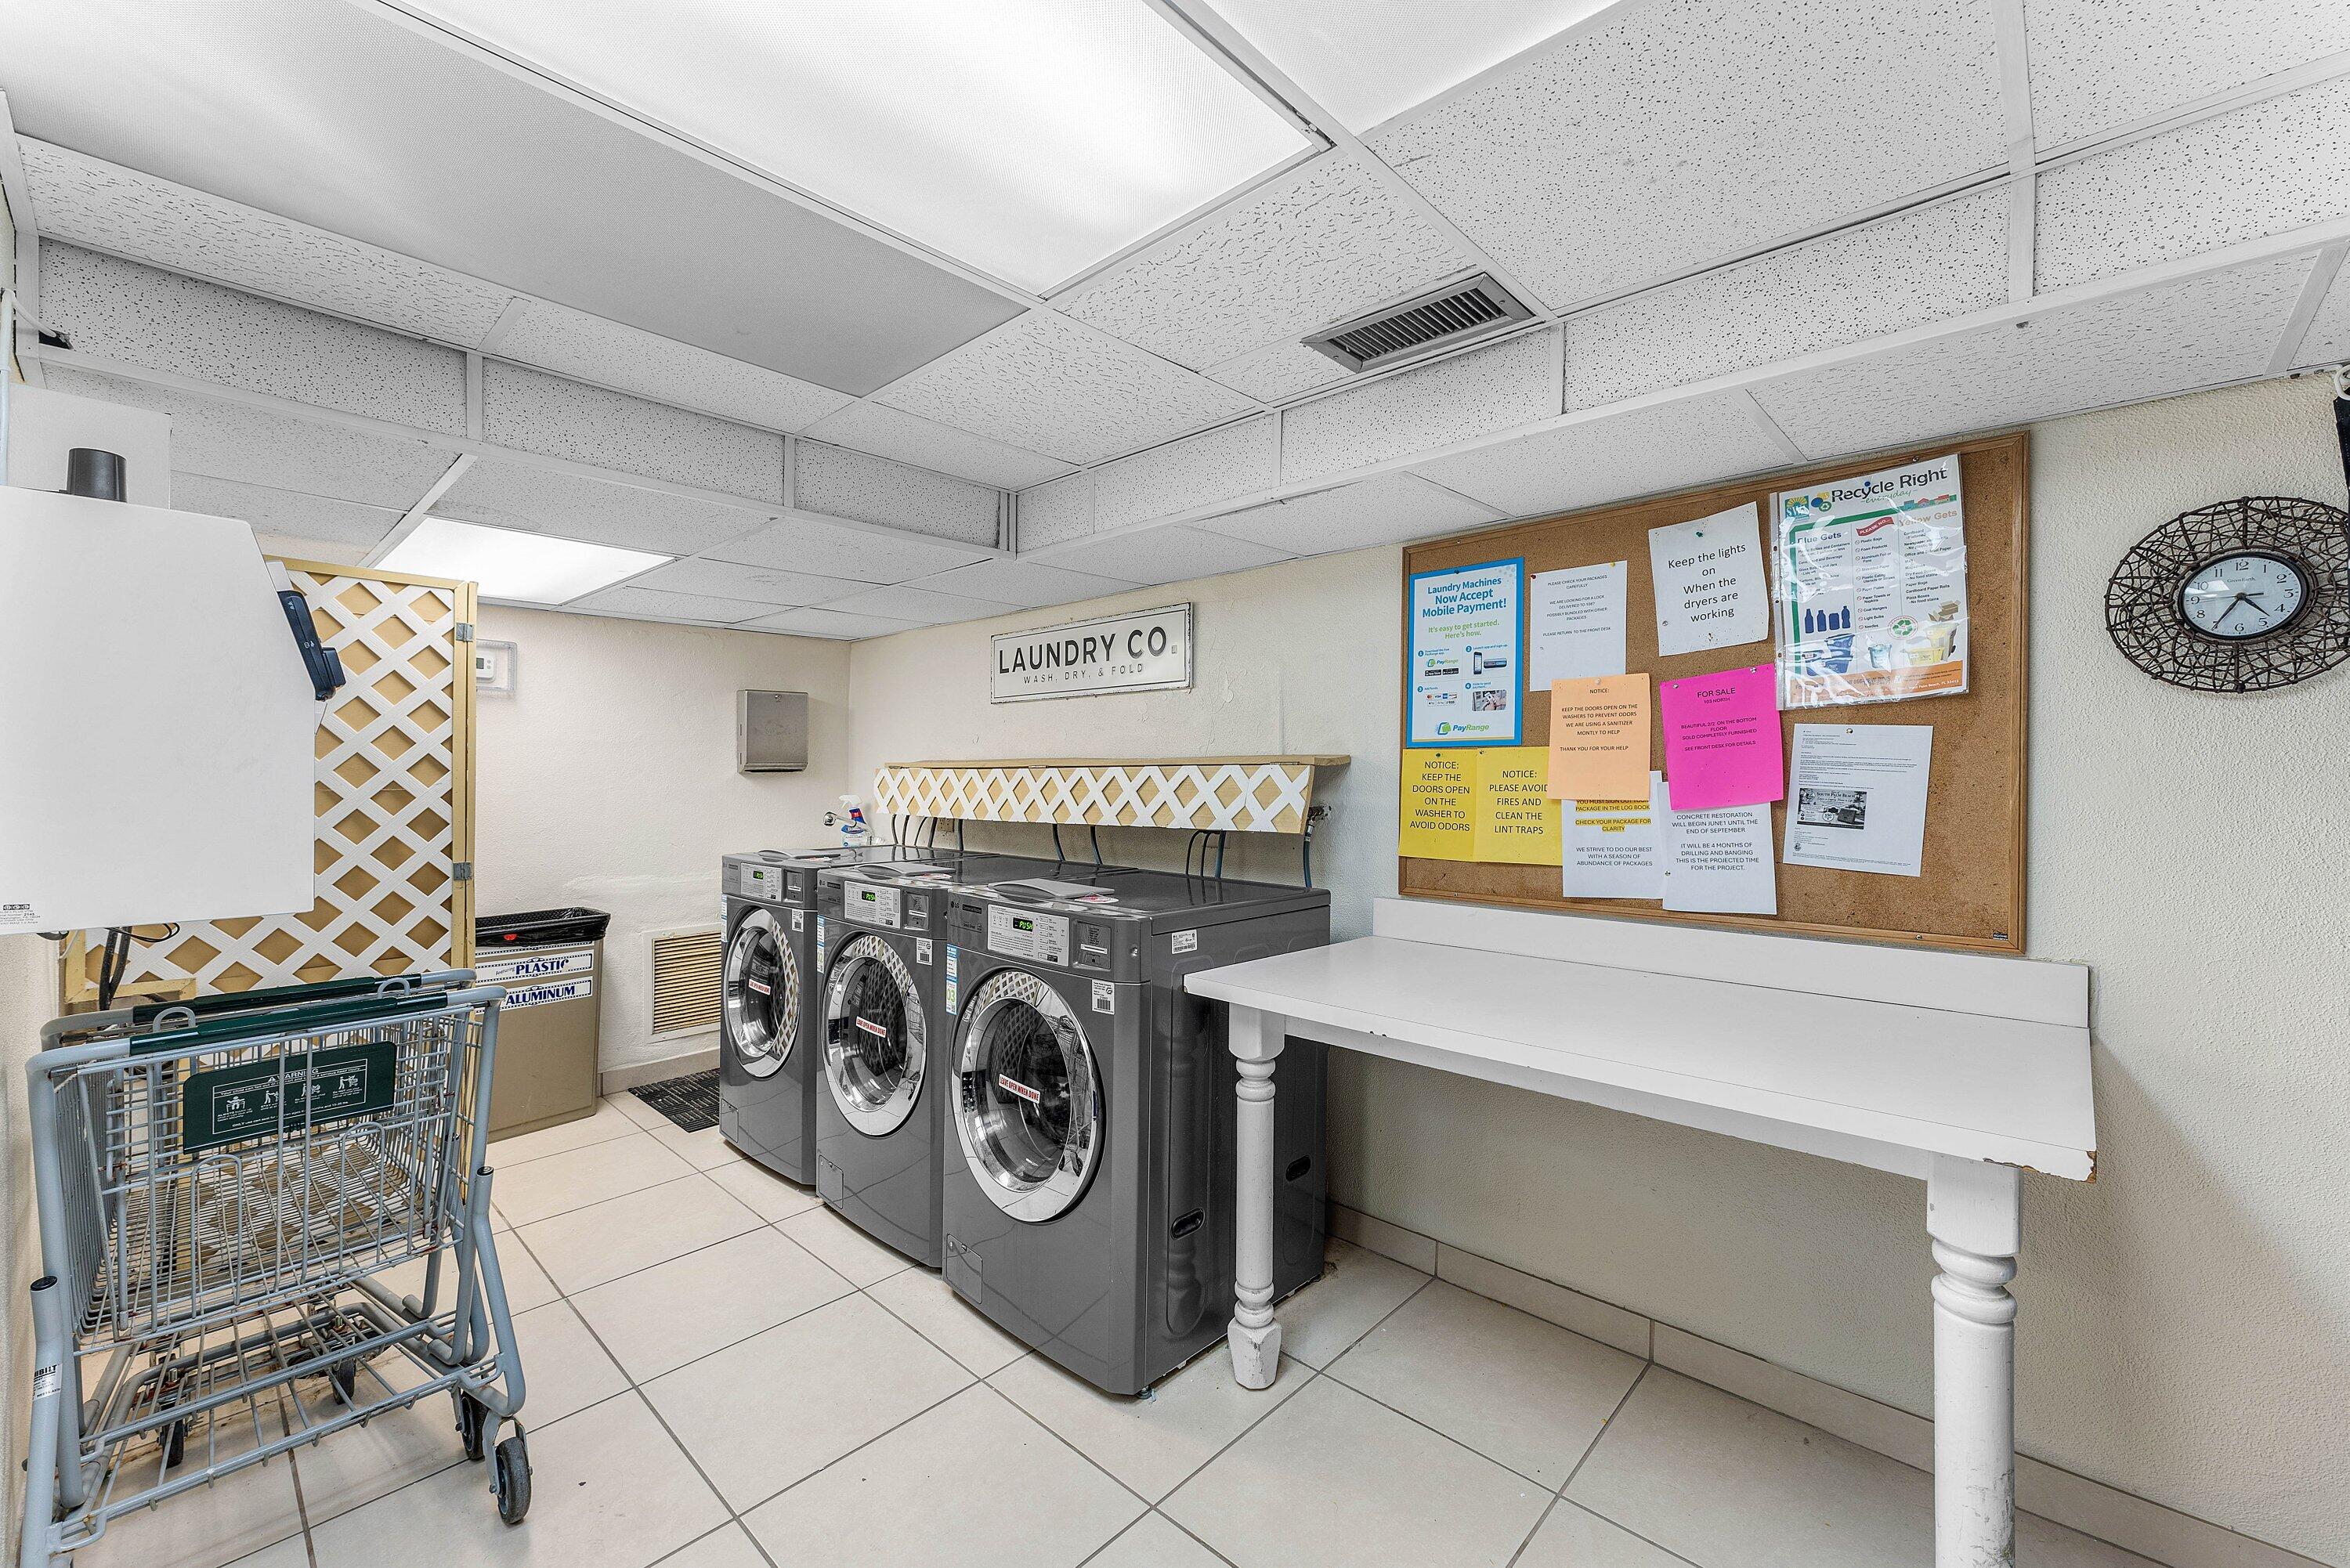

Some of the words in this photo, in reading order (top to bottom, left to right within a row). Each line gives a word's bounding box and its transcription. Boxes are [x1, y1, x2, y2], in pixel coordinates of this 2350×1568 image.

[1831, 482, 1894, 503] Recycle
[1900, 468, 1947, 488] Right
[1934, 510, 1958, 520] Gets
[1860, 525, 1878, 534] PLEASE
[1820, 532, 1842, 541] Gets
[1668, 557, 1695, 569] Keep
[1698, 553, 1716, 562] the
[1719, 544, 1746, 558] lights
[2236, 561, 2249, 571] 12
[2263, 564, 2267, 573] 1
[1702, 567, 1716, 576] on
[2214, 569, 2222, 577] 11
[2276, 573, 2287, 583] 2
[1428, 583, 1461, 594] Laundry
[1462, 578, 1502, 589] Machines
[1683, 581, 1716, 594] When
[1719, 577, 1737, 587] the
[2197, 580, 2208, 591] 10
[1435, 595, 1458, 605] Now
[1459, 589, 1493, 602] Accept
[2283, 588, 2294, 598] 3
[1684, 596, 1718, 609] dryers
[1721, 592, 1738, 602] are
[2191, 596, 2200, 605] 9
[1423, 605, 1455, 618] Mobile
[1457, 598, 1506, 614] Payment!
[2274, 603, 2286, 612] 4
[1690, 608, 1734, 622] working
[2196, 609, 2205, 618] 8
[1473, 620, 1500, 628] started.
[2258, 617, 2268, 626] 5
[2235, 623, 2244, 631] 6
[999, 633, 1115, 674] LAUNDRY
[1024, 673, 1058, 684] WASH,
[1065, 670, 1090, 681] DRY,
[1112, 663, 1143, 675] FOLD
[1715, 688, 1736, 696] SALE
[1452, 724, 1490, 733] PayRange
[1445, 786, 1470, 794] OPEN
[1415, 809, 1452, 818] WASHER
[1410, 821, 1436, 829] AVOID
[1437, 822, 1470, 831] ODORS
[515, 959, 569, 975] PLASTIC
[506, 985, 575, 1006] ALUMINUM
[278, 1068, 319, 1081] ARNIG
[1000, 1076, 1009, 1087] LEAVE
[1008, 1082, 1017, 1091] OPEN
[1018, 1086, 1029, 1097] WHEN
[1029, 1089, 1039, 1101] DONE
